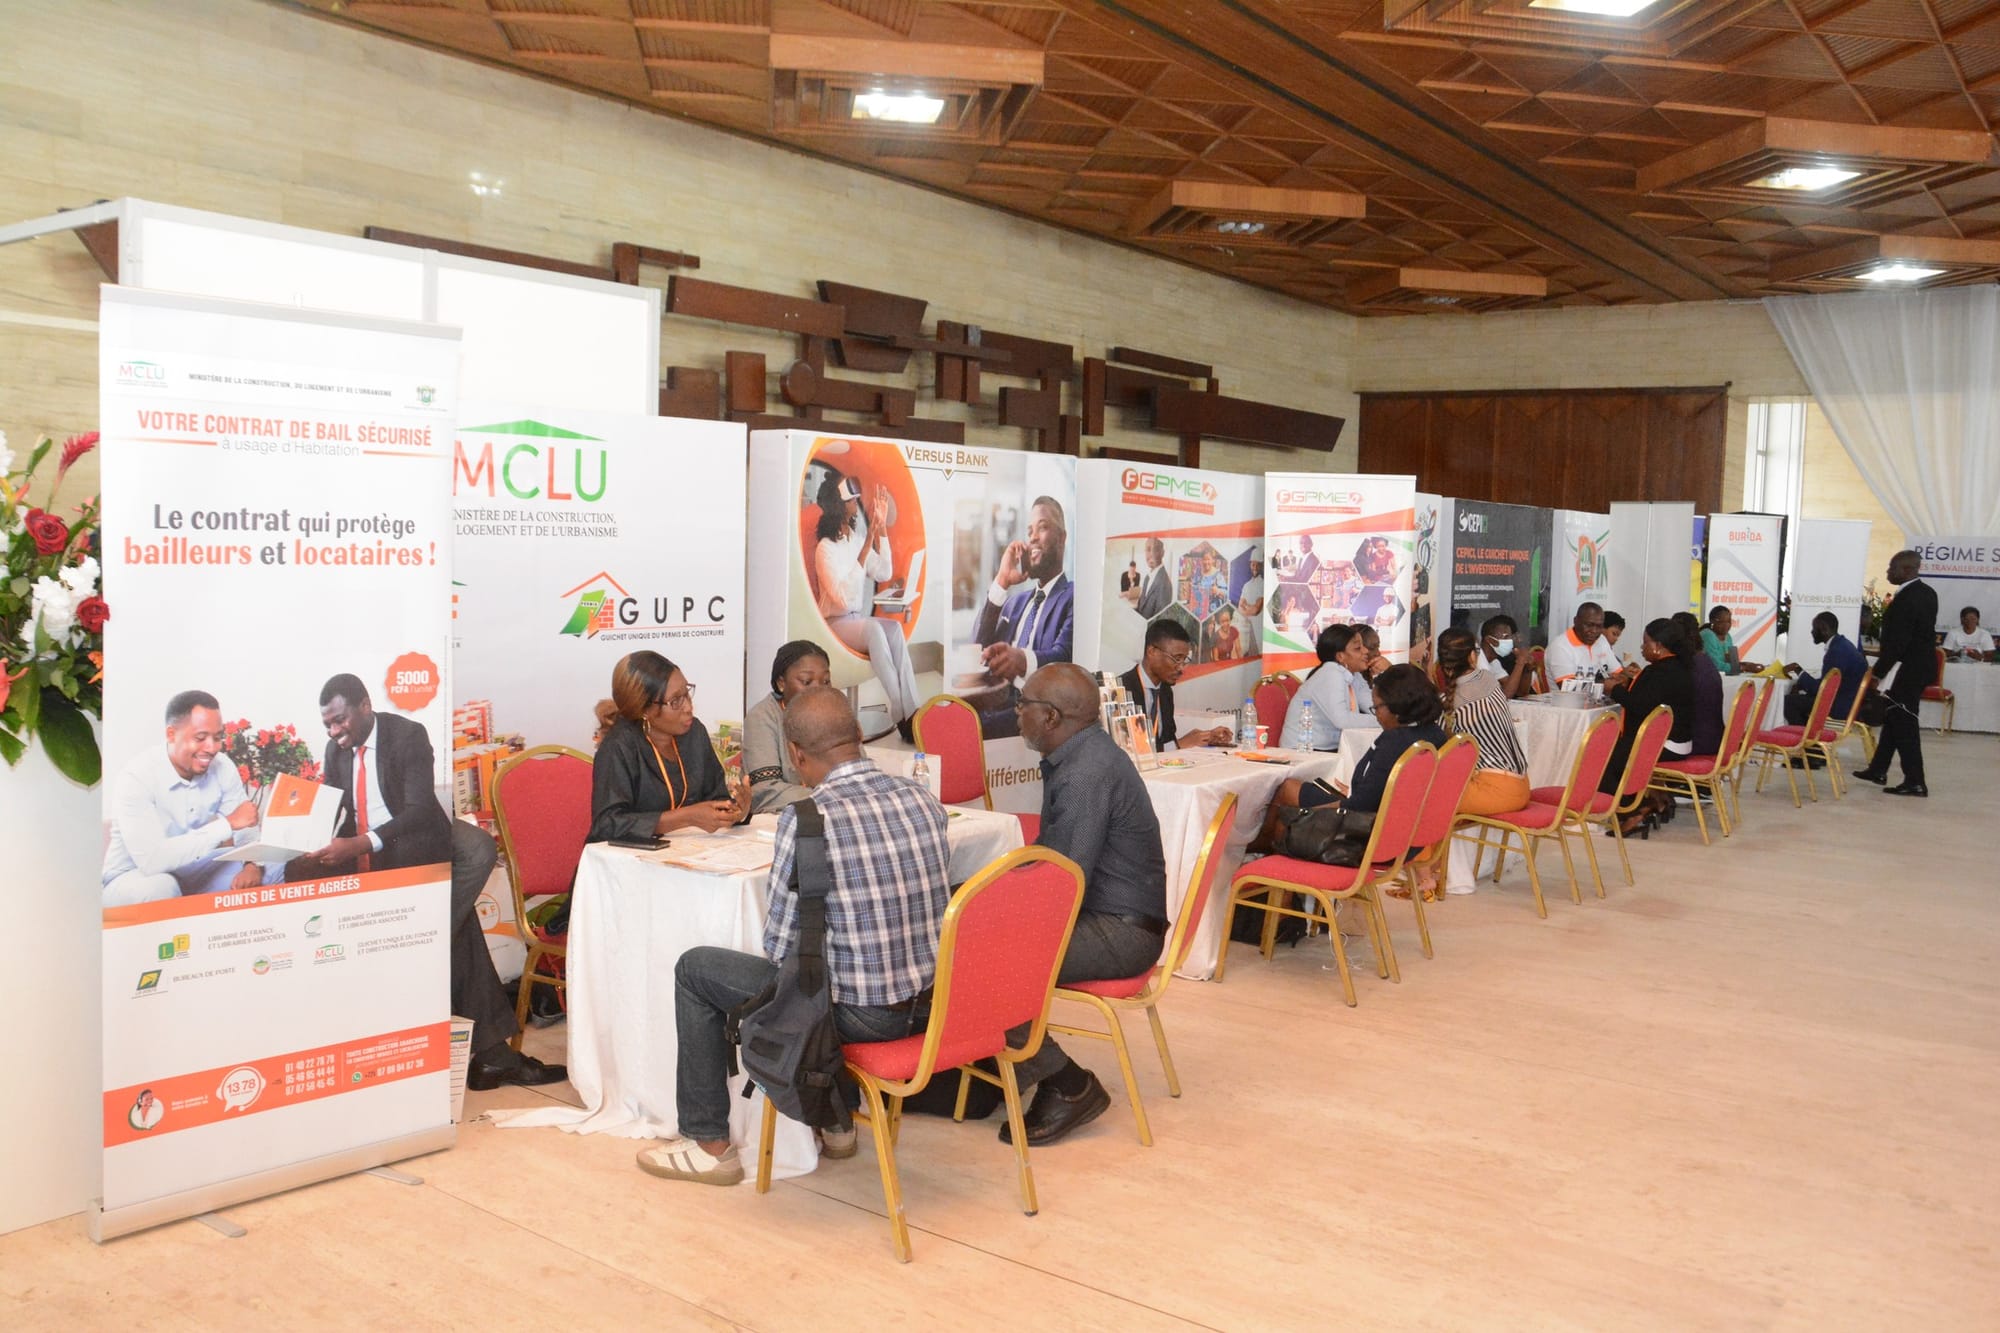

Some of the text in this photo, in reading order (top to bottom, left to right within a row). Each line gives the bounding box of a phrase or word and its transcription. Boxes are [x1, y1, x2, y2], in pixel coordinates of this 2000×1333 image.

[119, 365, 165, 380] MCLU
[224, 376, 232, 384] DE
[234, 377, 242, 385] LA
[137, 409, 432, 447] VOTRE CONTRAT DE BAIL SÉCURISÉ
[222, 438, 360, 457] à usage d'Habitation
[452, 440, 607, 502] MCLU
[153, 503, 416, 540] Le contrat qui protège
[502, 510, 517, 522] DE
[520, 510, 534, 522] LA
[456, 524, 618, 538] LOGEMENT ET DE L'URBANISME
[124, 536, 252, 565] bailleurs
[259, 541, 287, 565] et
[294, 538, 423, 566] locataires
[1915, 542, 1984, 562] RÉGIME
[1456, 563, 1465, 574] DE
[1919, 563, 1929, 571] ES
[1932, 563, 1991, 573] TRAVAILLEURS
[1712, 581, 1753, 591] RESPECTER
[1721, 594, 1738, 603] droit
[619, 595, 725, 626] GUPC
[600, 633, 627, 642] GUICHET
[628, 632, 650, 640] UNIQUE
[661, 631, 681, 639] PERMIS
[682, 630, 690, 638] DE
[691, 629, 725, 638] CONSTRUIRE
[396, 670, 429, 686] 5000
[214, 876, 361, 909] POINTS DE VENTE AGRÉÉS
[315, 945, 345, 959] MCLU
[227, 1082, 240, 1095] 13
[242, 1078, 256, 1091] 78
